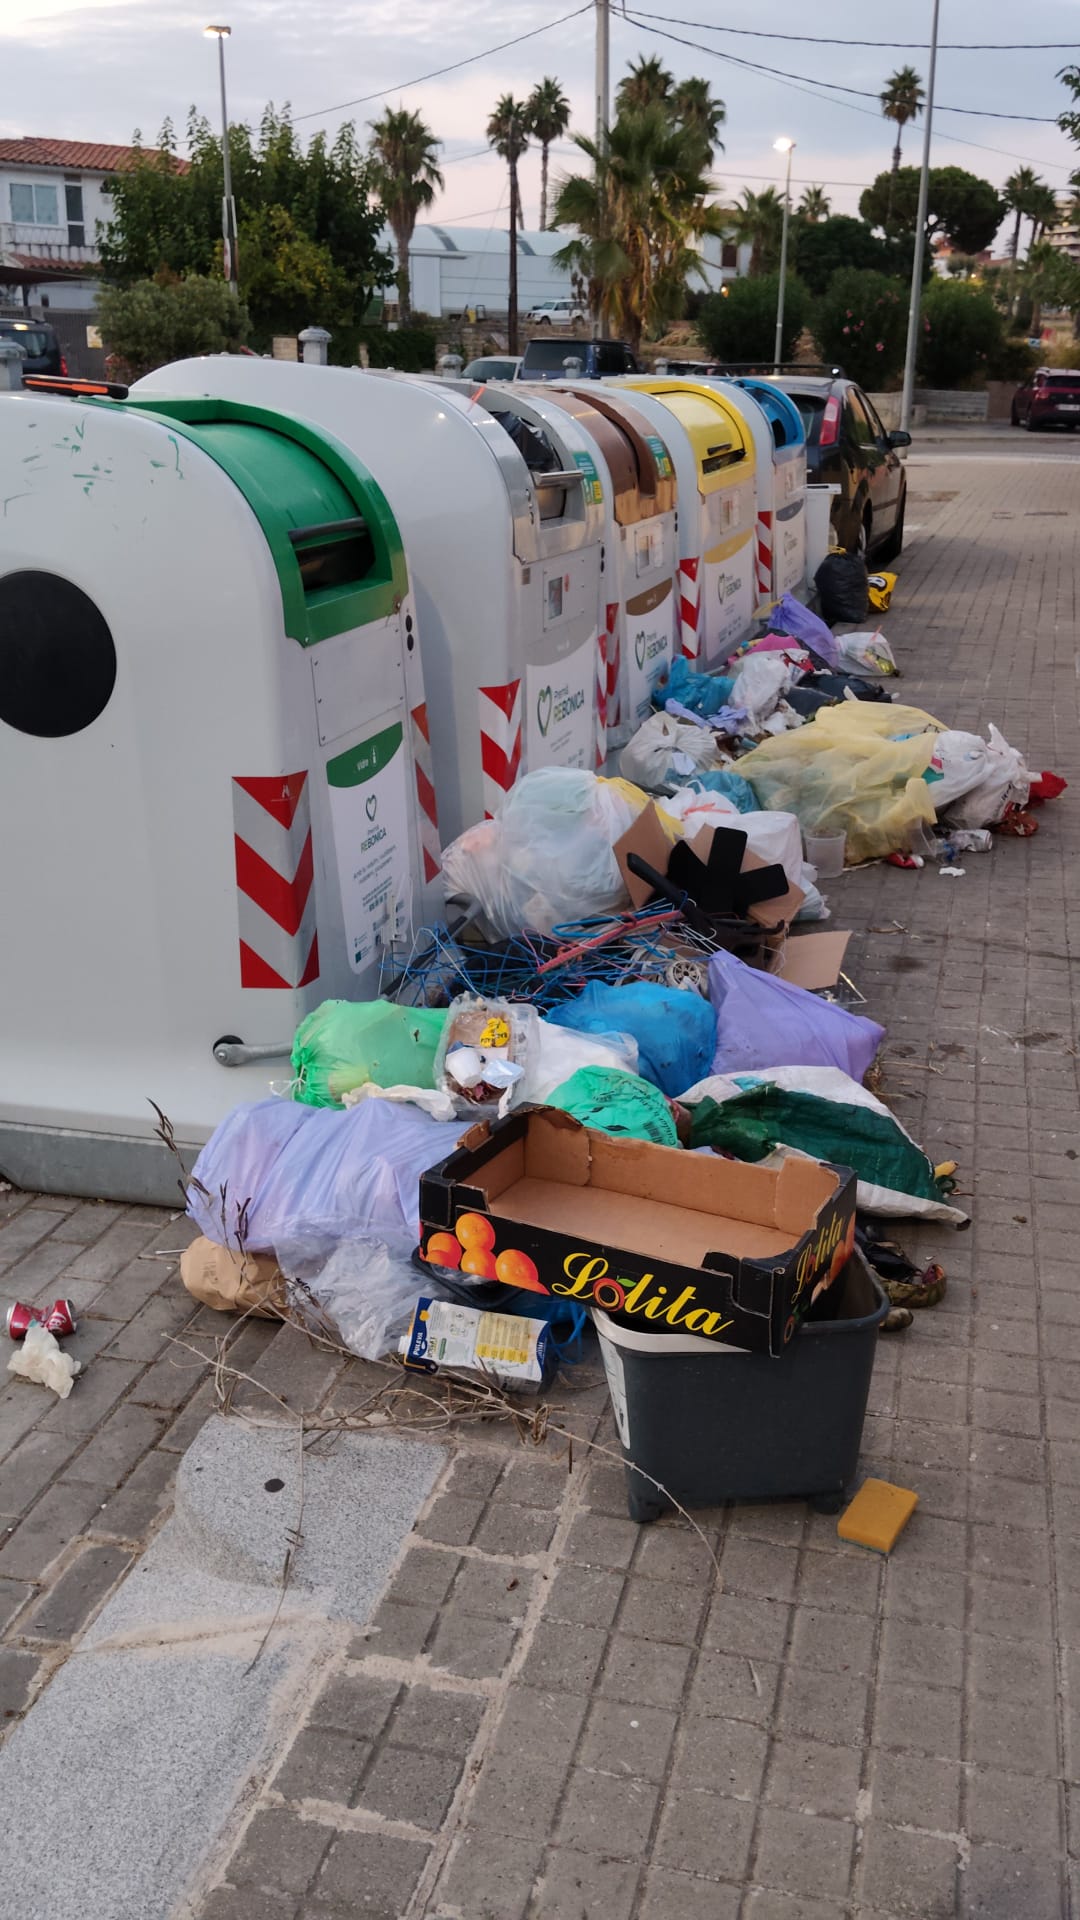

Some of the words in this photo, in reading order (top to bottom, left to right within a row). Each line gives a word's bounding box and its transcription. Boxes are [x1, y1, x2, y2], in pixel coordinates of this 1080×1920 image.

[553, 689, 585, 725] REBONICA
[360, 827, 387, 854] REBONICA
[791, 1211, 845, 1304] Lolita
[551, 1252, 735, 1337] Lolita
[412, 1331, 424, 1356] PULEVA
